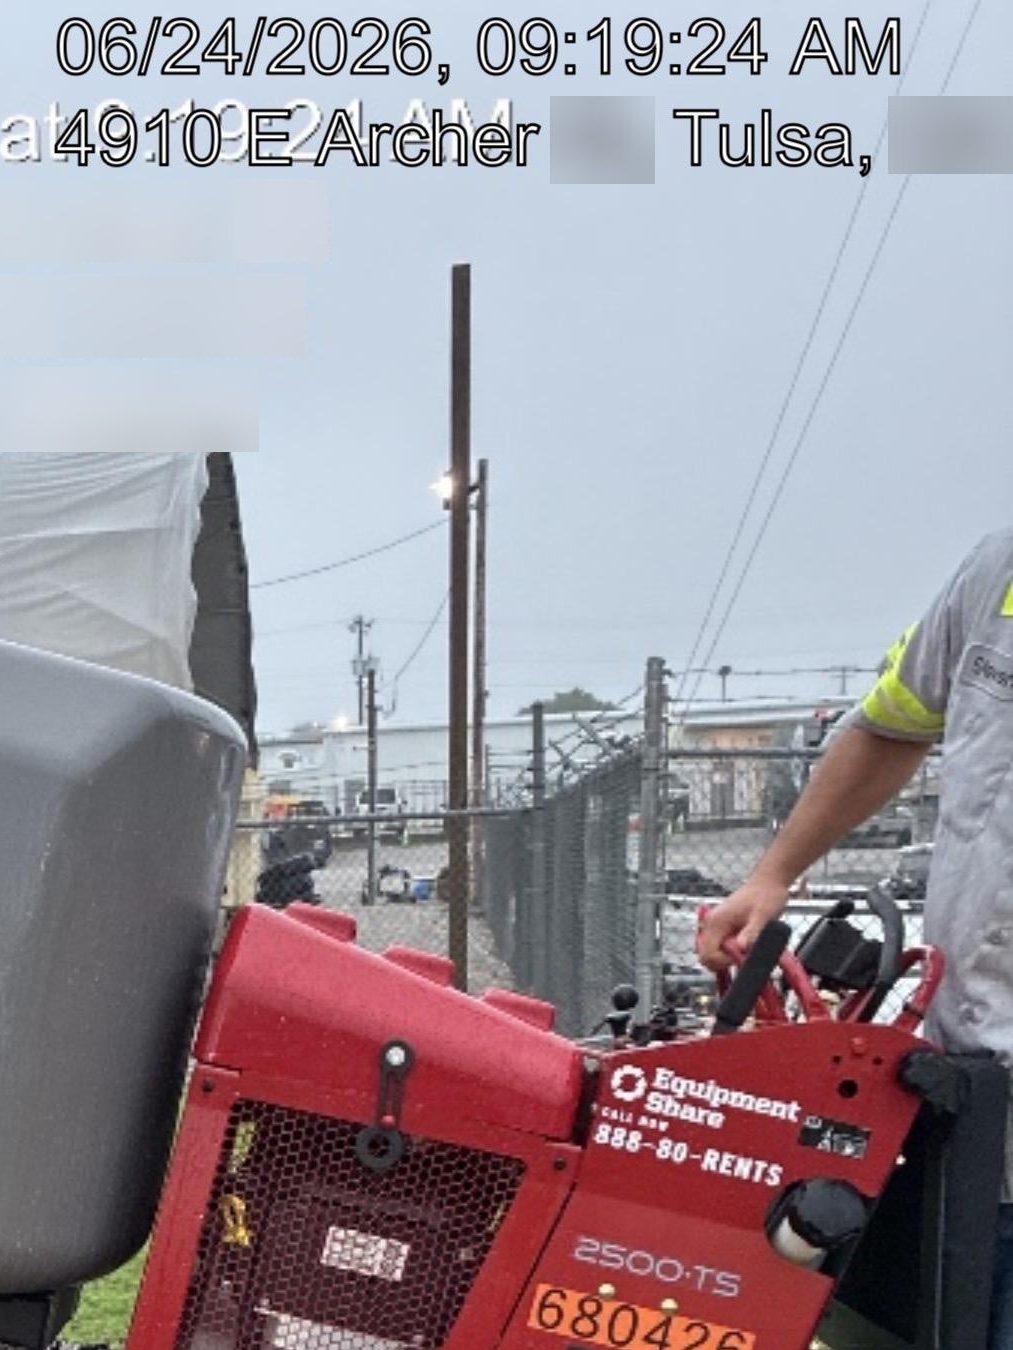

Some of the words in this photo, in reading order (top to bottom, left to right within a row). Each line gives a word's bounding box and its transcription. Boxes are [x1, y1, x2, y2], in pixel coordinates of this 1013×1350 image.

[644, 1091, 726, 1129] Share
[651, 1067, 802, 1123] Equipment
[594, 1123, 784, 1187] 888-80-RENTS
